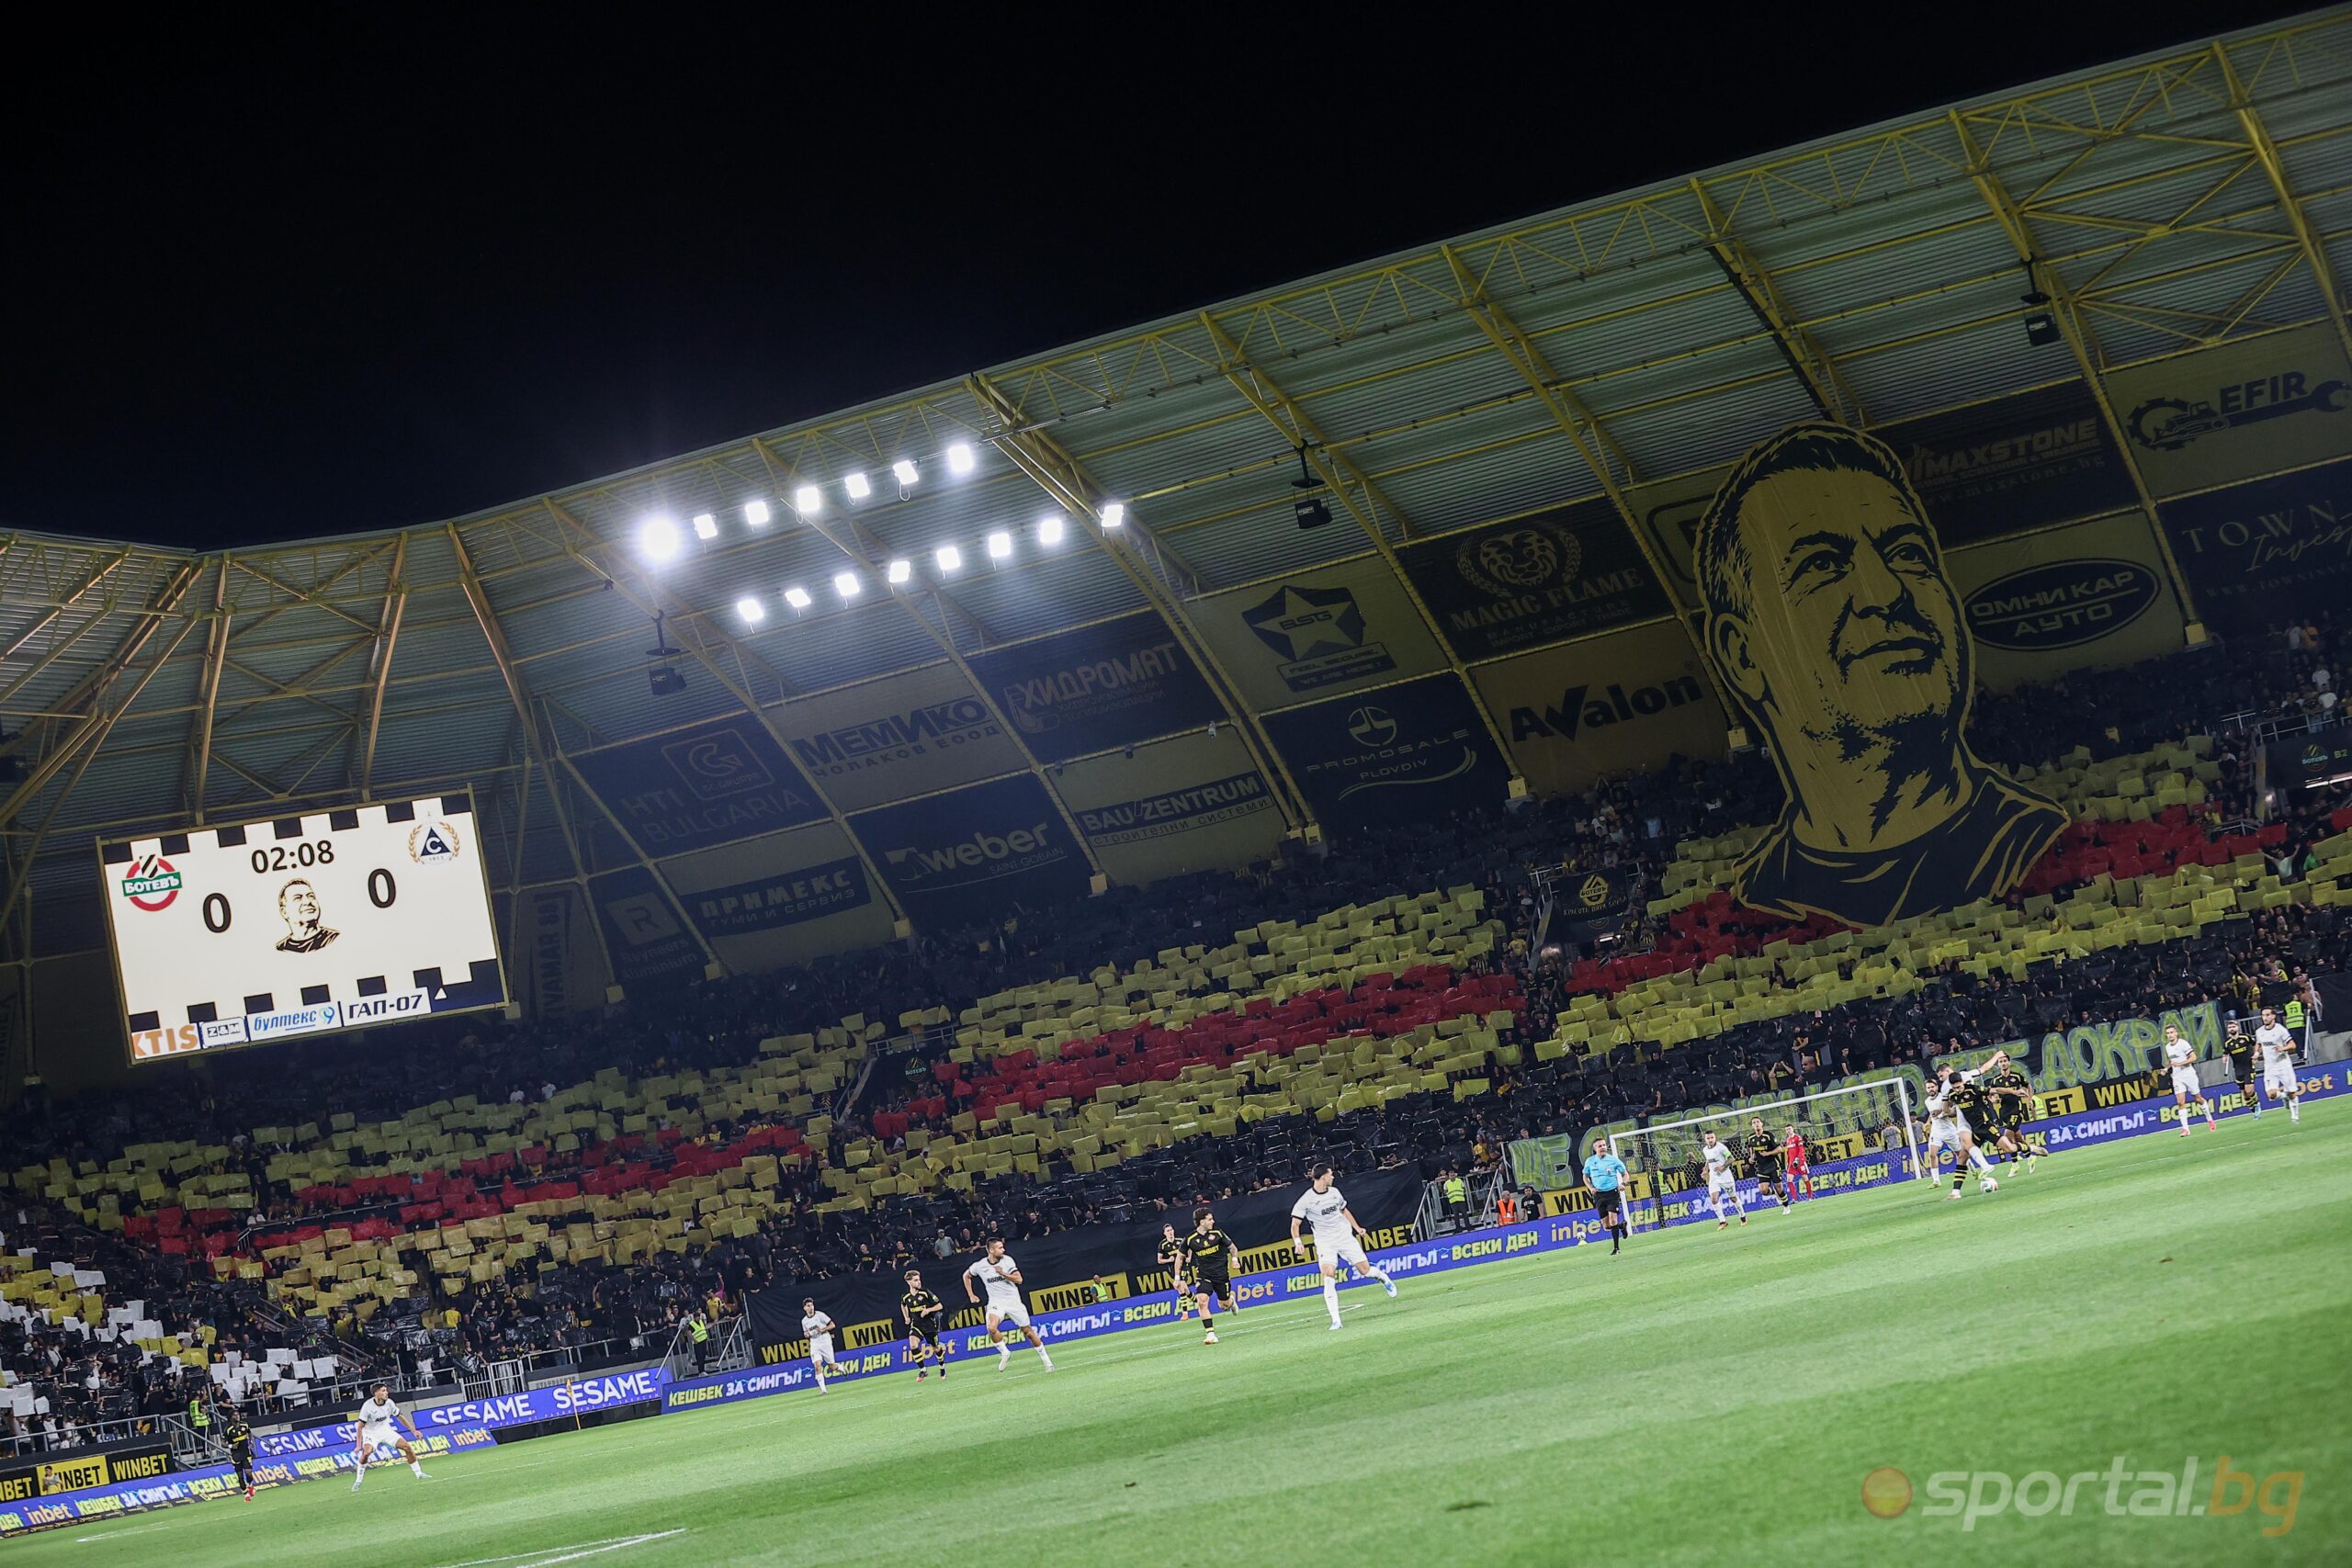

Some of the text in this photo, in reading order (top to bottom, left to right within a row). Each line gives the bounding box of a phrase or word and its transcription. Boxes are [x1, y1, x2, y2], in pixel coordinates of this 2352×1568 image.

[2219, 370, 2308, 414] EFIR
[1930, 416, 2098, 477] MAXSTONE
[2181, 500, 2338, 553] TOWN
[1449, 567, 1645, 632] MAGIC FLAME
[1971, 570, 2136, 617] ОМНИ КАР
[2014, 603, 2113, 638] АУТО
[1015, 643, 1177, 710] ХИДРОМАТ
[792, 700, 988, 768] МЕМИКО
[813, 725, 1001, 778] ЧОЛАКОВ ЕООД
[1306, 728, 1470, 773] PROMOSALE
[1360, 758, 1428, 780] PLOVDIV
[620, 787, 686, 818] HTI
[644, 789, 810, 843] BULGARIA
[1081, 776, 1261, 831] BAU ZENTRUM
[251, 840, 335, 874] 02:08
[922, 823, 1049, 873] weber
[123, 875, 182, 896] БОТЕВЪ
[367, 867, 397, 909] 0
[698, 870, 853, 919] ПРИМЕКС
[785, 891, 857, 915] СЕРВИЗ
[202, 892, 233, 934] 0
[254, 1009, 317, 1032] бултекс
[348, 994, 423, 1020] ГАП-07
[2095, 1080, 2143, 1110] WIN
[1855, 1162, 1889, 1186] ДЕН
[2050, 1127, 2073, 1145] ЗА
[2077, 1111, 2144, 1140] СИНГЪЛ
[1355, 1223, 1416, 1251] INBET
[1551, 1220, 1605, 1242] inbe
[1196, 1245, 1220, 1257] WINBET
[1377, 1248, 1438, 1275] СИНГЪЛ
[1452, 1236, 1504, 1262] ВСЕКИ
[1506, 1230, 1539, 1254] ДЕН
[1040, 1280, 1118, 1311] WINBT
[1052, 1312, 1111, 1337] СИНГЪЛ
[1124, 1300, 1172, 1325] ВСЕКИ
[668, 1384, 724, 1407] КЕШБЕК
[725, 1378, 745, 1396] ЗА
[747, 1368, 803, 1393] СИНГЪЛ
[862, 1352, 892, 1374] ДЕН
[296, 1455, 339, 1475] КЕШБЕК
[428, 1434, 451, 1451] ДЕН
[450, 1427, 492, 1446] inbet
[54, 1465, 101, 1491] INBET
[112, 1454, 167, 1481] WINBET
[24, 1503, 74, 1525] inbet
[75, 1495, 125, 1515] КЕШБЕК
[120, 1490, 140, 1507] ЗА
[139, 1485, 182, 1504] СИНГЪЛ
[187, 1477, 223, 1495] ВСЕКИ
